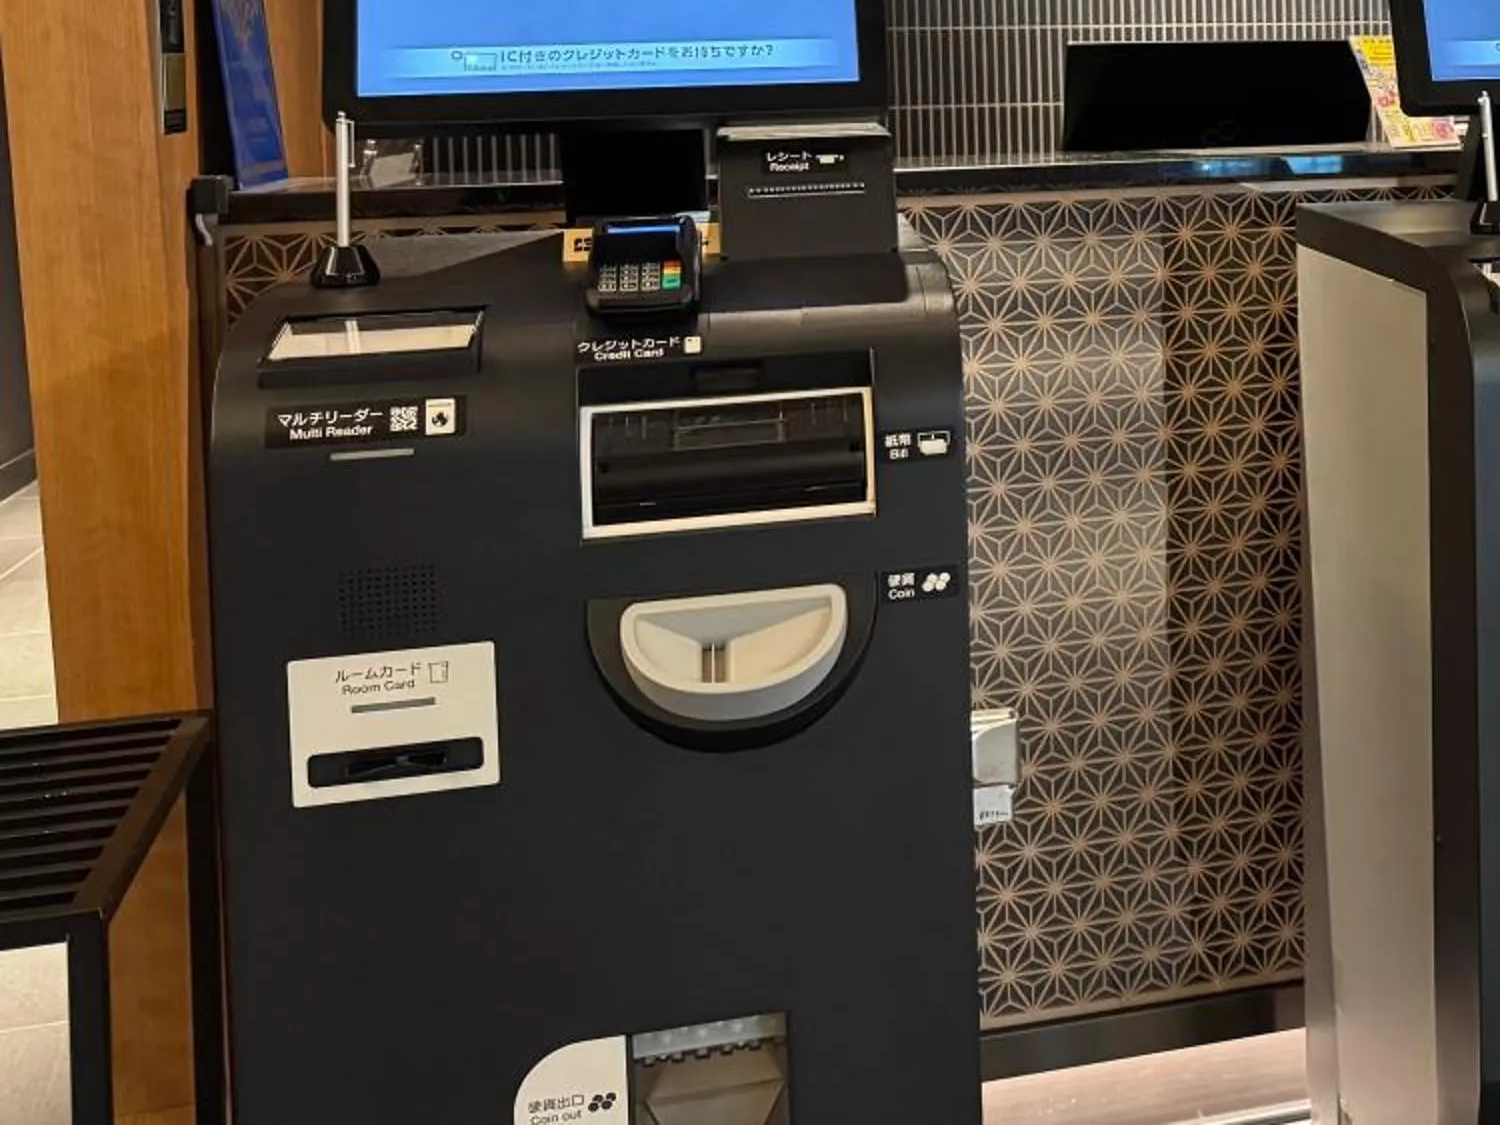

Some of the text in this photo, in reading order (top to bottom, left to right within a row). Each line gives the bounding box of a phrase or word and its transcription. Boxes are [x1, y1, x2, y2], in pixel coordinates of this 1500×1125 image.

[766, 150, 813, 163] レシート
[577, 336, 681, 353] クレジットカード
[593, 348, 665, 362] Credit Card
[277, 407, 384, 428] マルチリーダー
[289, 424, 373, 441] Multi Reader
[887, 588, 915, 600] Coin
[335, 662, 422, 683] ルームカード
[341, 678, 416, 696] Room Card
[527, 1094, 585, 1114] 硬貨出口
[562, 1109, 583, 1122] out
